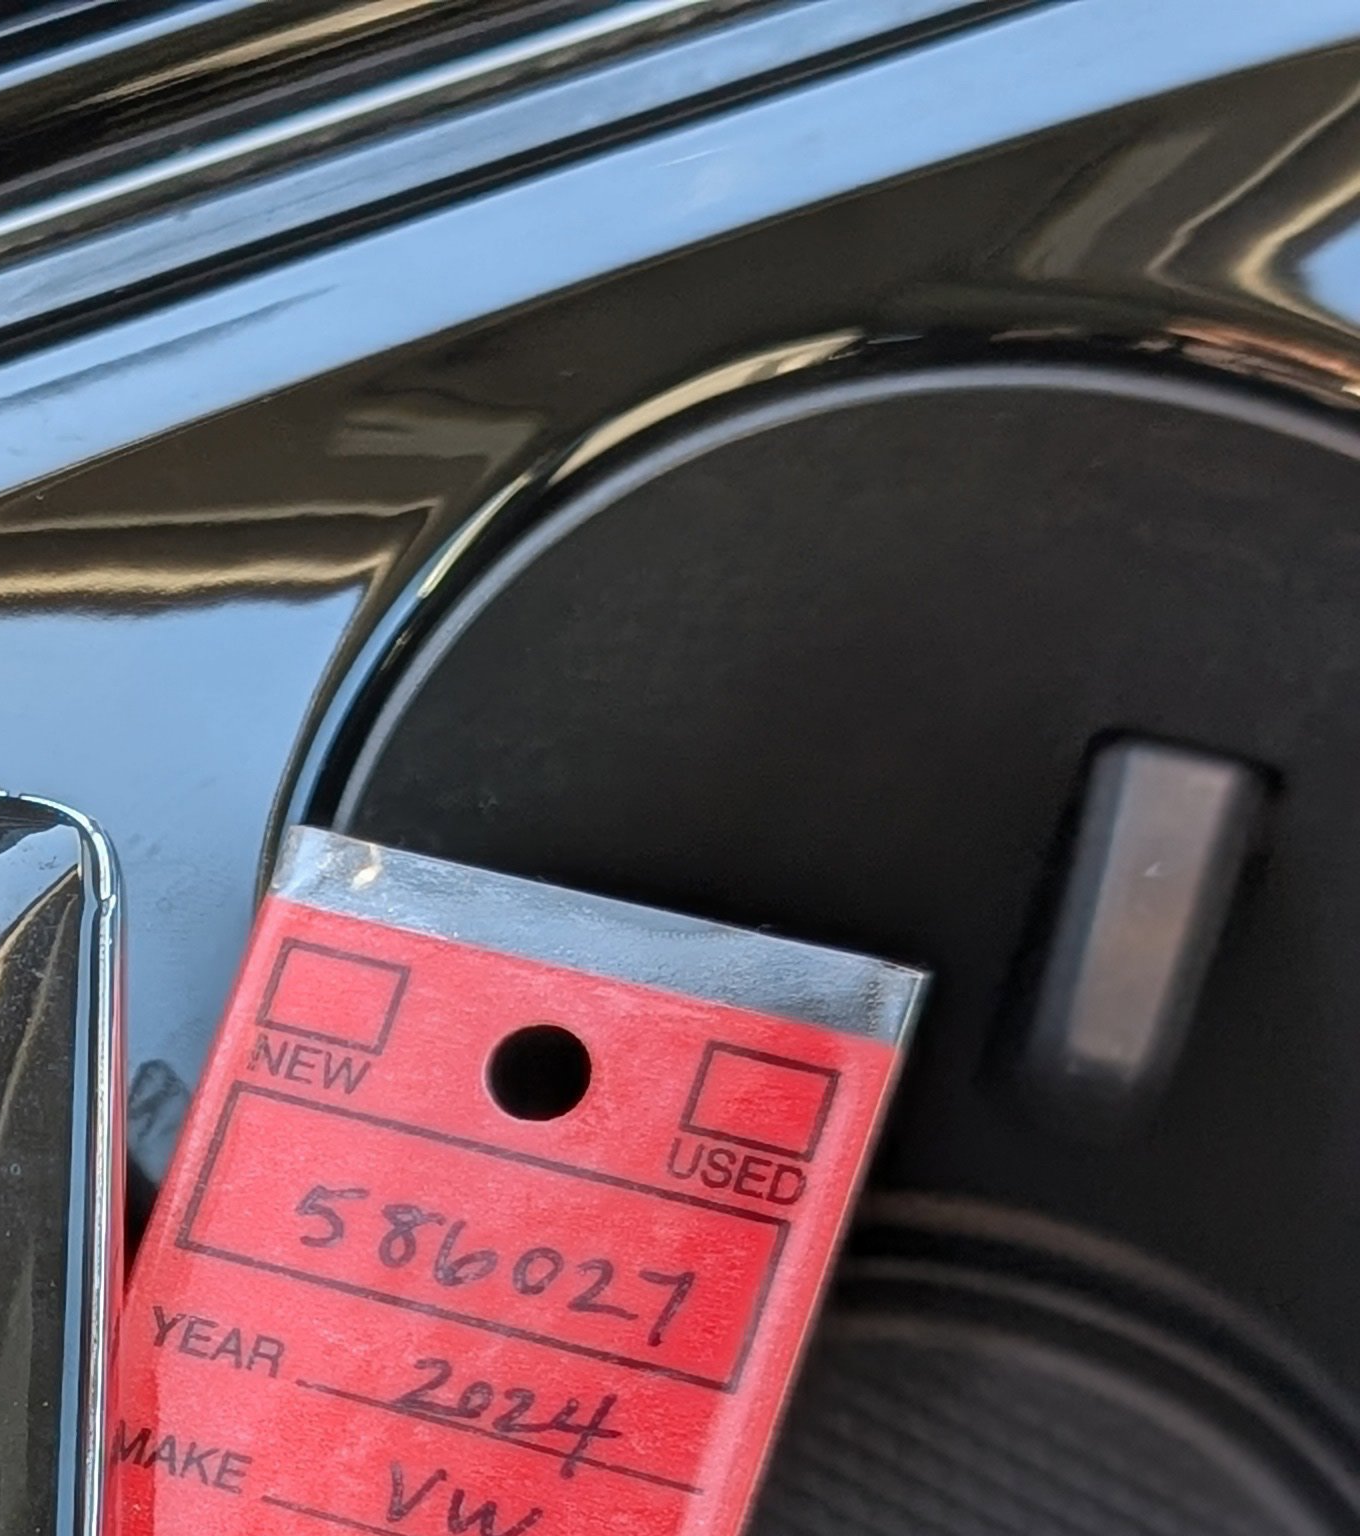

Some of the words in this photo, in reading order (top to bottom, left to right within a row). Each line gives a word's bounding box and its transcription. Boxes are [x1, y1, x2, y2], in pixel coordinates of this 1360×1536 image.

[247, 1033, 371, 1095] NEW
[667, 1137, 808, 1207] USED
[296, 1184, 696, 1348] 586027
[152, 1305, 286, 1375] YEAR
[393, 1356, 622, 1480] 2024
[109, 1419, 253, 1495] MAKE
